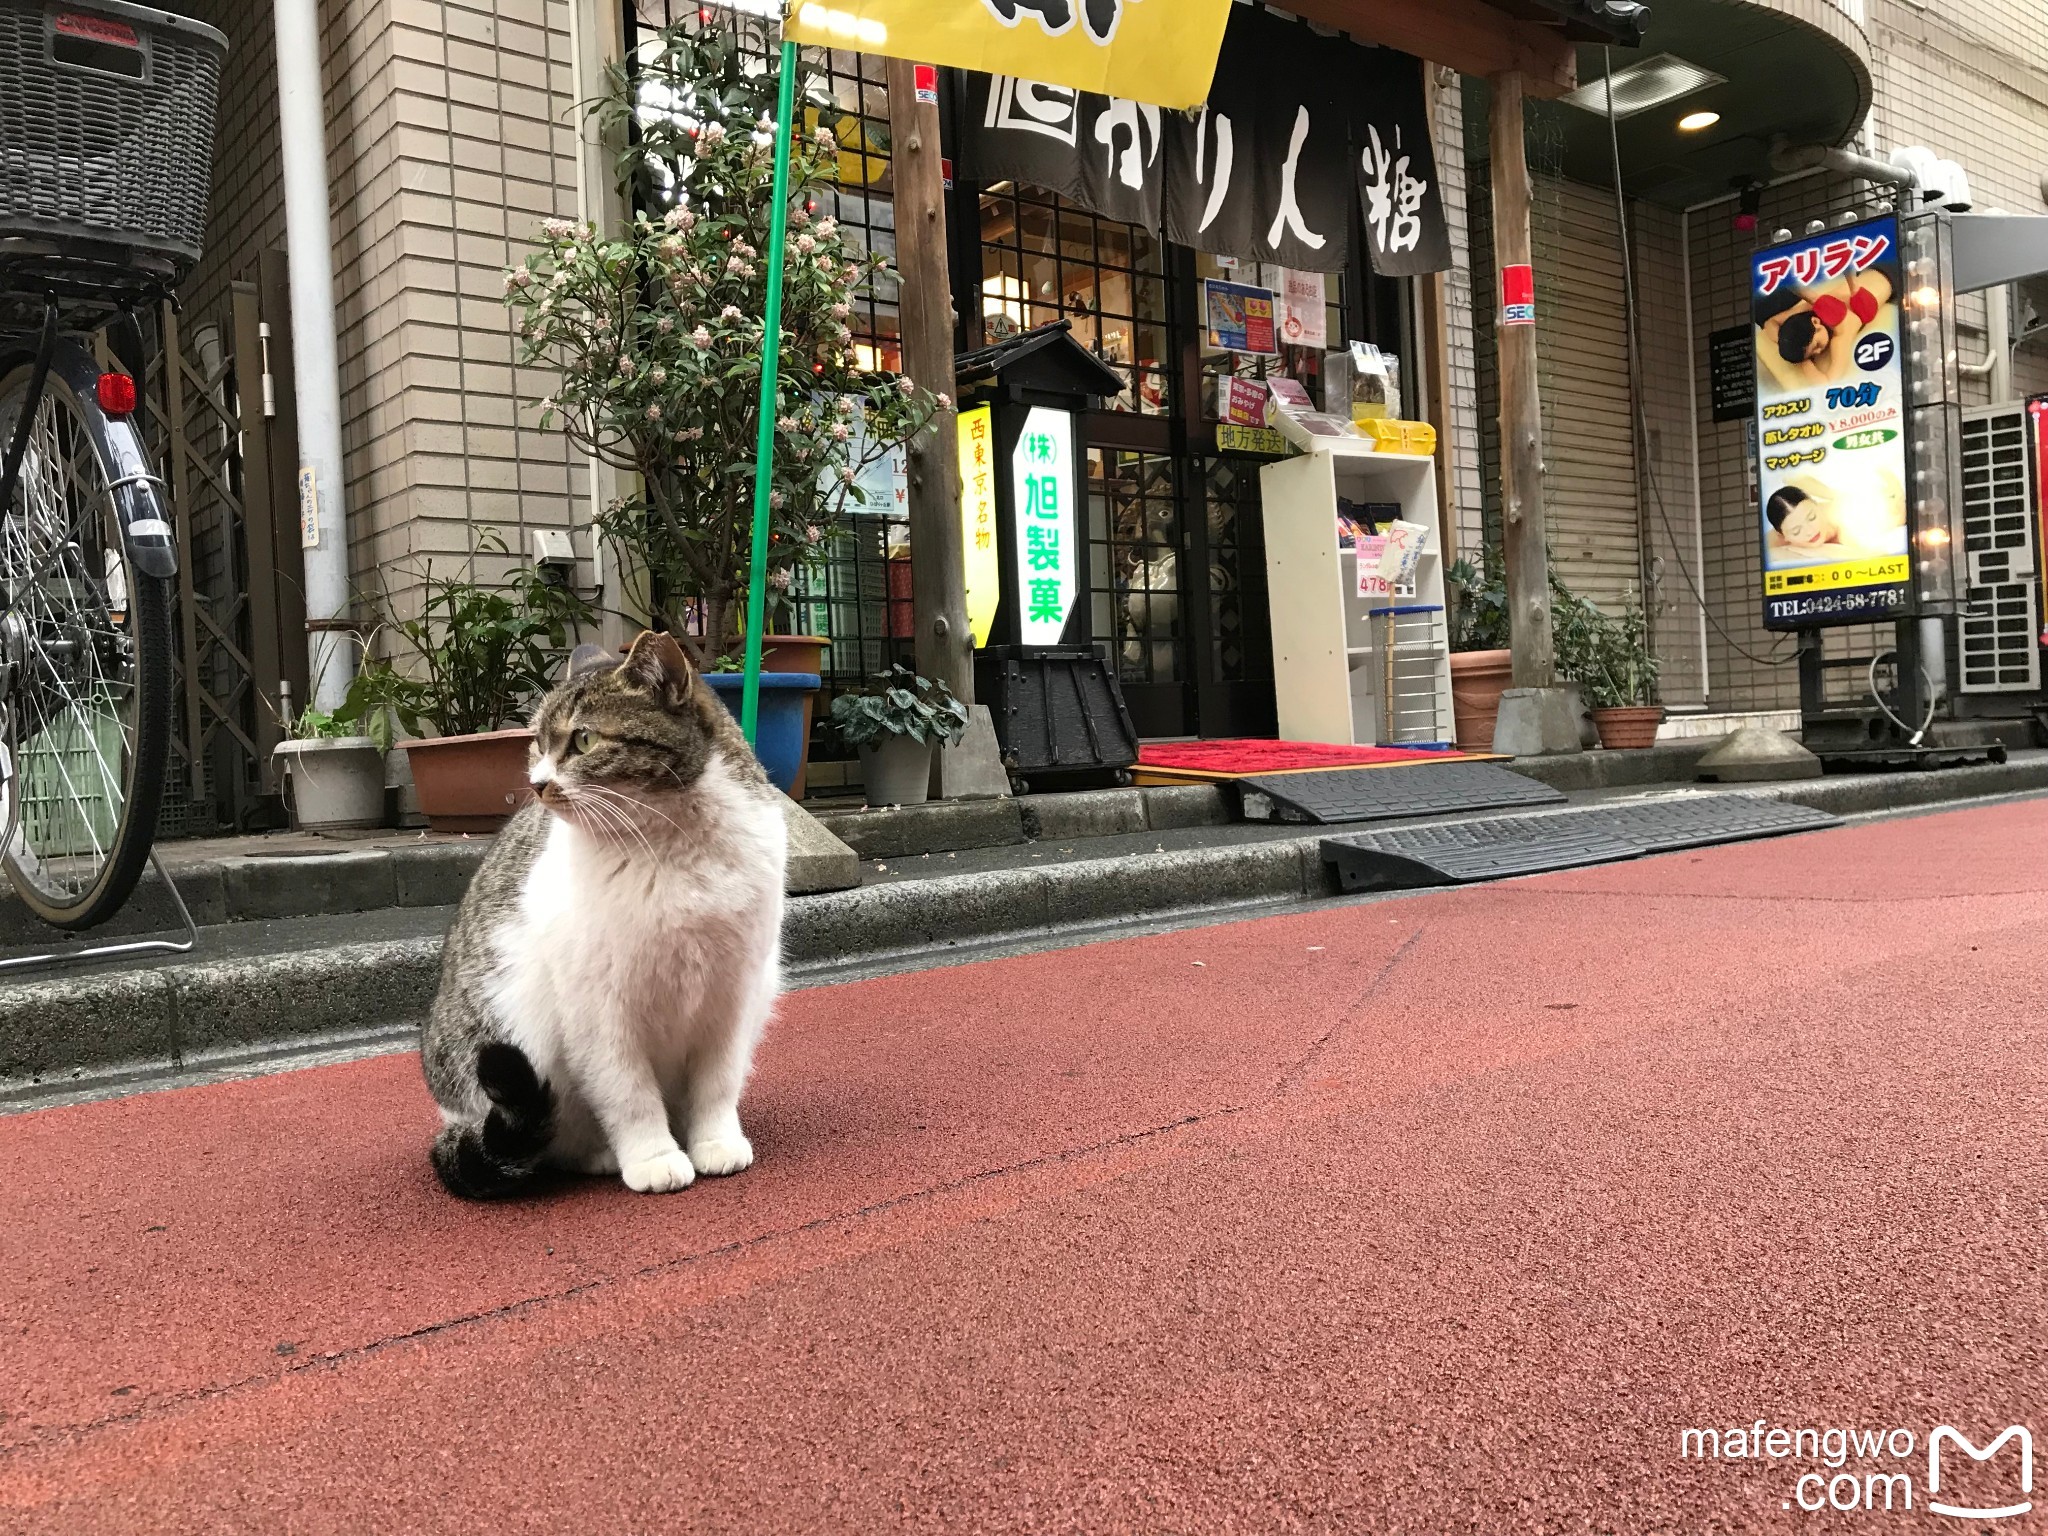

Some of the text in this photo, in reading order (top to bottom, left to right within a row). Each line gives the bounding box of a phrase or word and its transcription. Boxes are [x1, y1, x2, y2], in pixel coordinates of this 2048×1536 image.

[1760, 235, 1889, 295] アリラン
[1858, 340, 1891, 364] 2F
[1826, 382, 1882, 409] 70分
[1763, 398, 1811, 419] アカスリ
[1221, 427, 1281, 453] 地方発送
[1764, 422, 1825, 446] 蒸しタオル
[1765, 447, 1826, 470] マッサージ
[970, 417, 990, 551] 西東京名物
